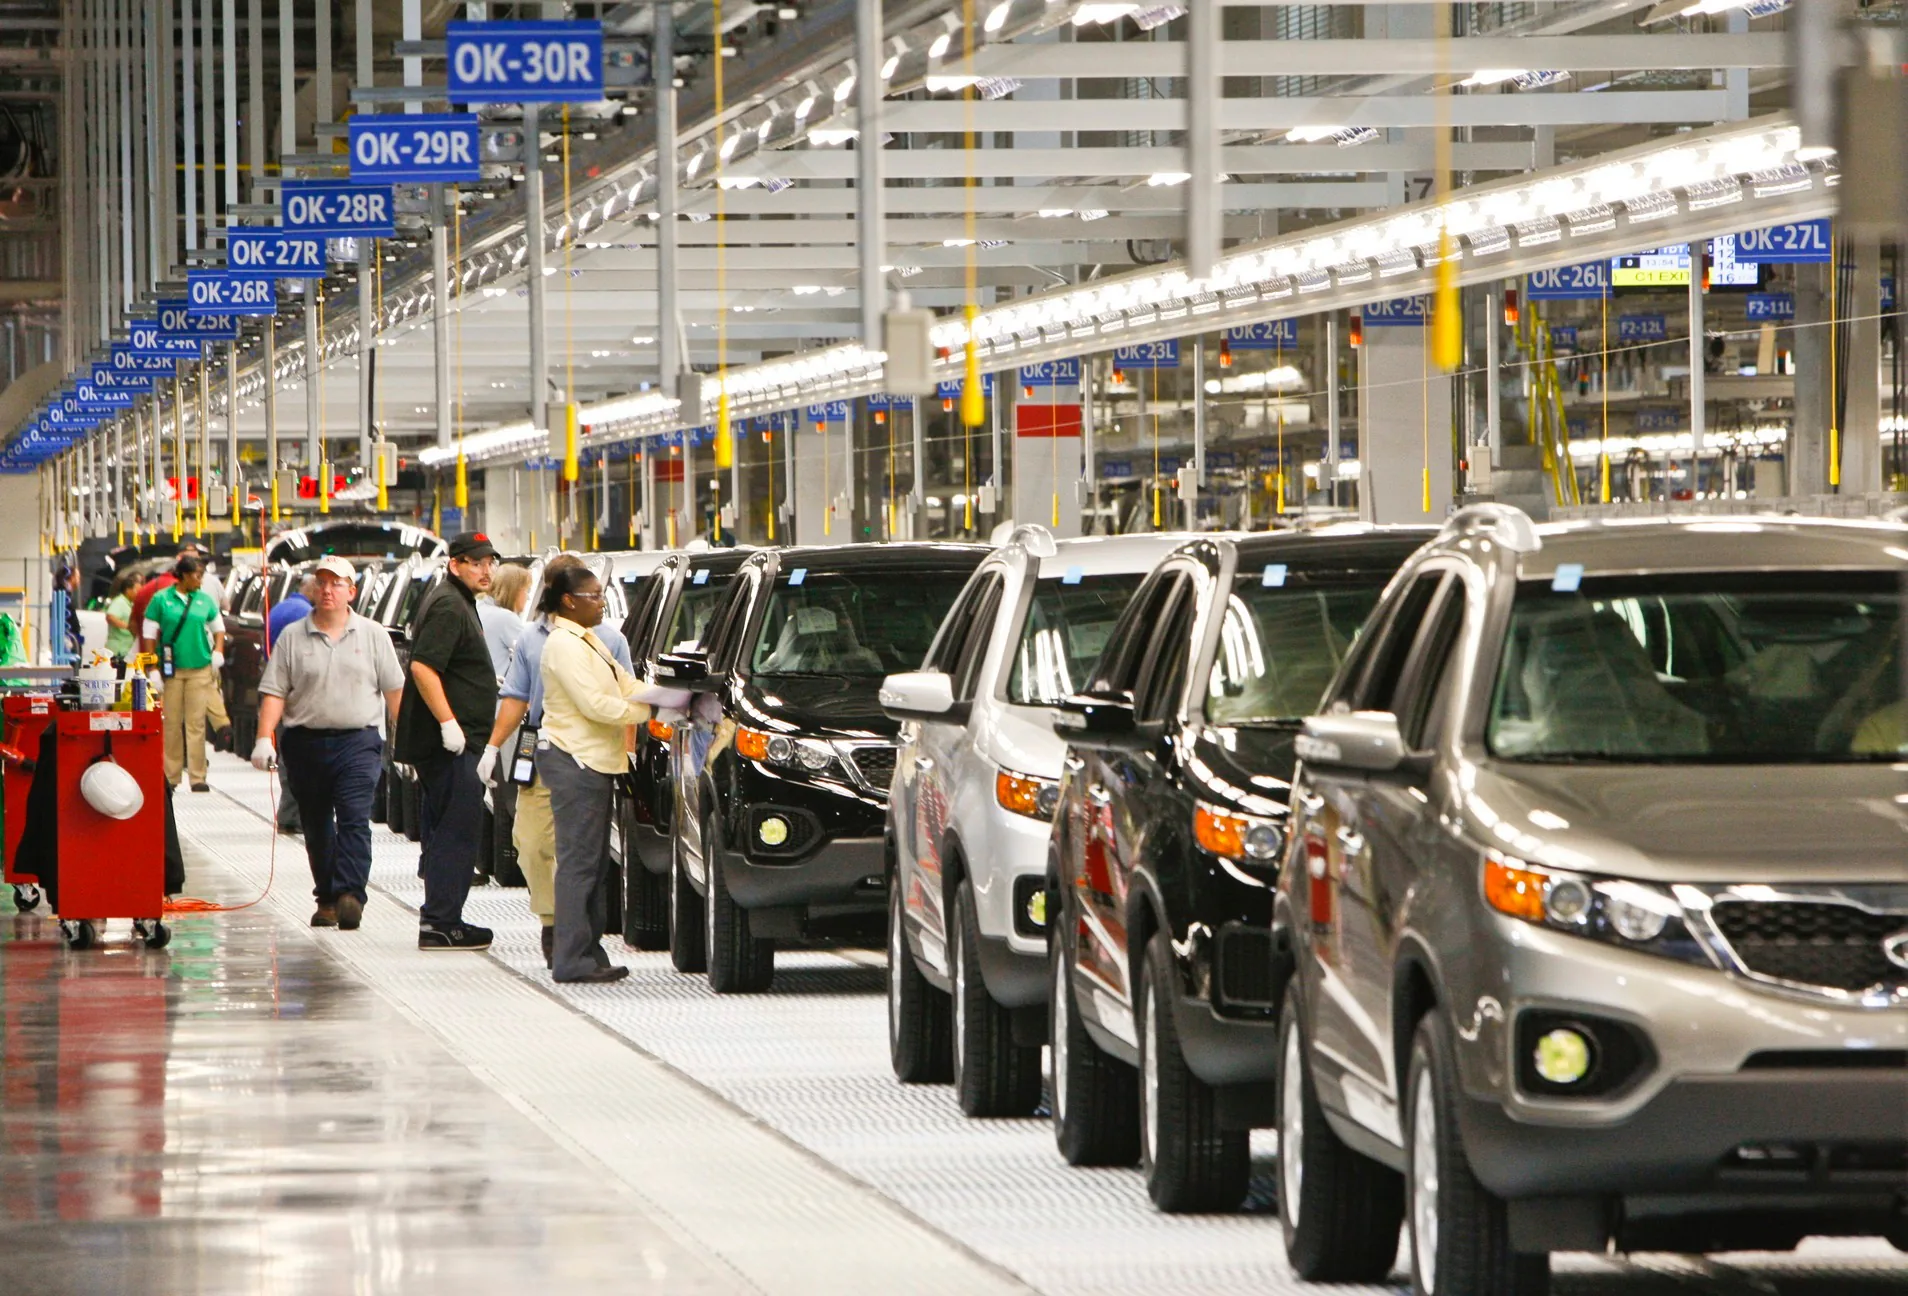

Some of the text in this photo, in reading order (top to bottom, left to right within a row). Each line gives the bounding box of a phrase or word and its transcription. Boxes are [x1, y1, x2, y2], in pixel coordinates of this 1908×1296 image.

[455, 42, 593, 82] OK-30R
[356, 131, 473, 166] OK-29R
[288, 194, 388, 224] OK-28R
[1740, 224, 1826, 250] OK-27L
[232, 239, 320, 266] OK-27R
[1532, 264, 1608, 289] OK-26L
[192, 280, 270, 304] OK-26R
[161, 309, 232, 330] OK-25R
[1232, 319, 1294, 340] OK-24L
[1117, 342, 1176, 361] OK-23L
[1022, 361, 1077, 379] OK-22L
